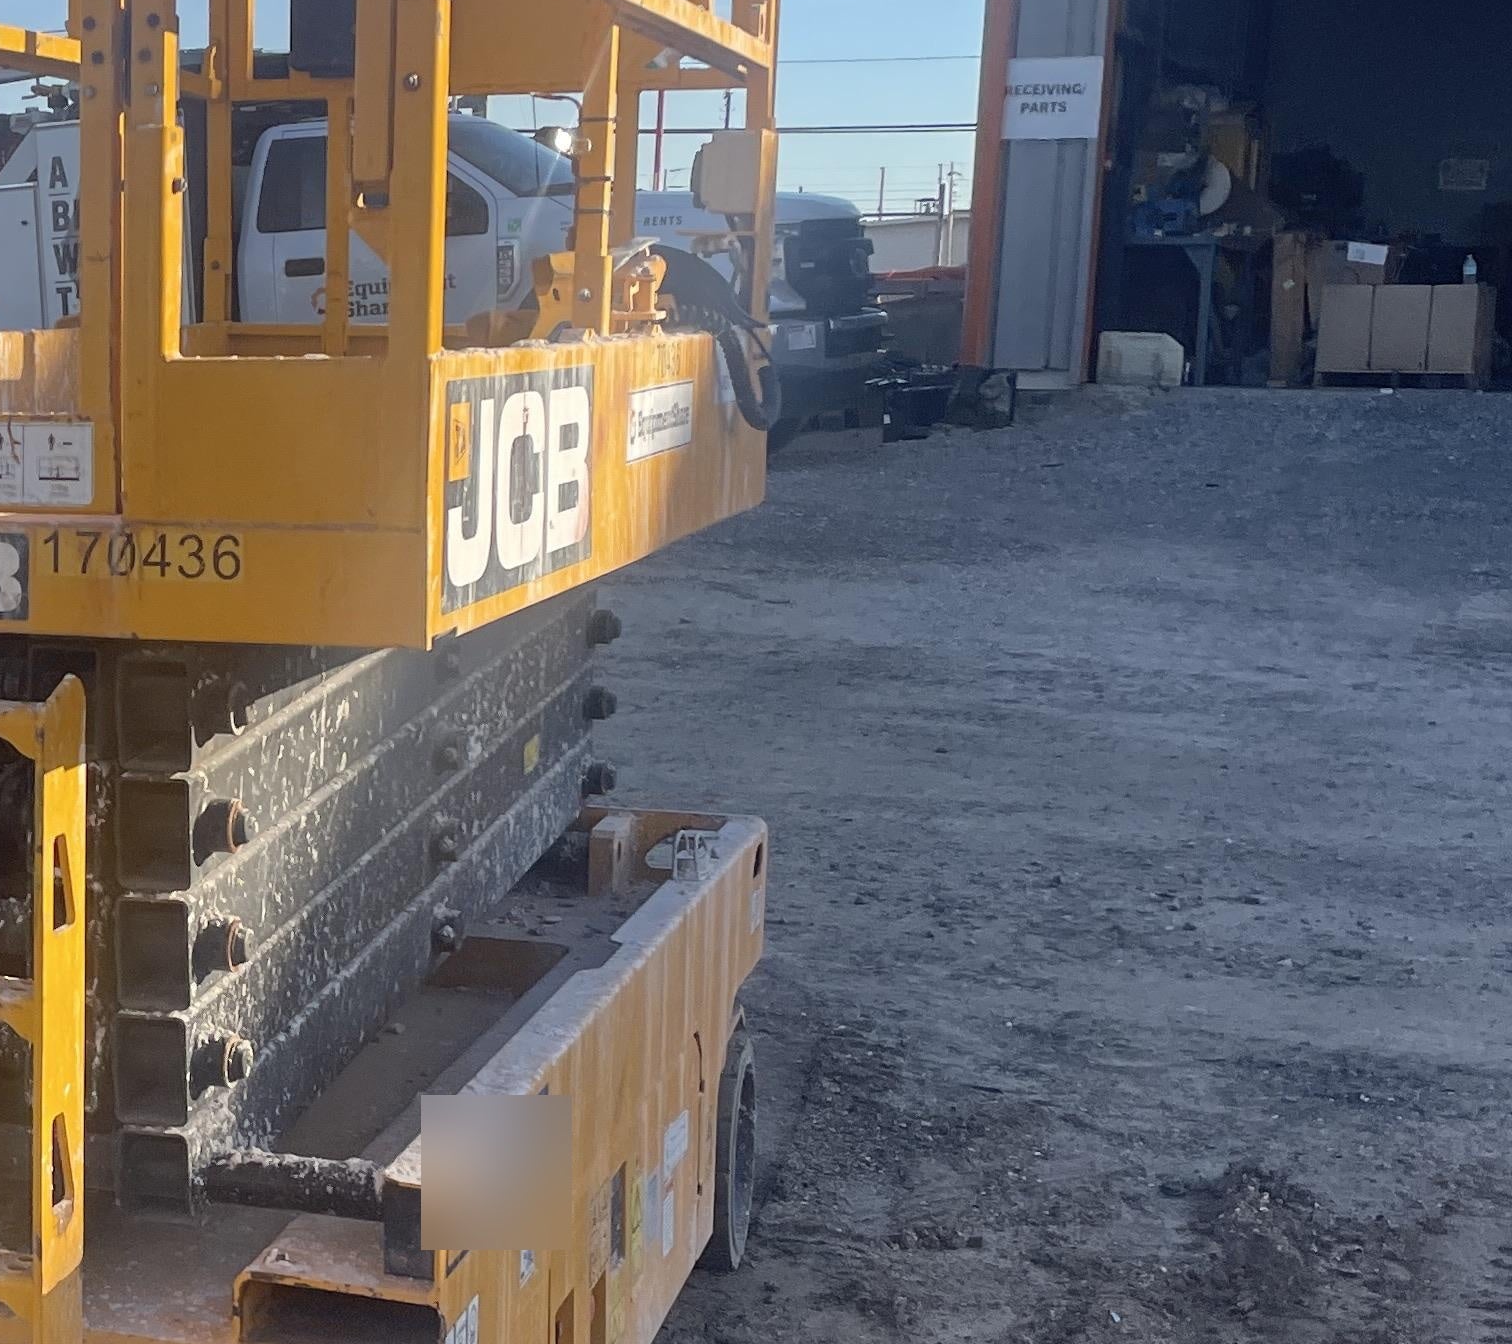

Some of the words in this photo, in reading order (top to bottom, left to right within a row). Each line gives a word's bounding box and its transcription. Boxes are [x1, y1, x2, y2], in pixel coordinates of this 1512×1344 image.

[1020, 101, 1068, 113] PARTS
[49, 156, 68, 189] A
[446, 386, 589, 587] JCB
[43, 531, 242, 580] 170436
